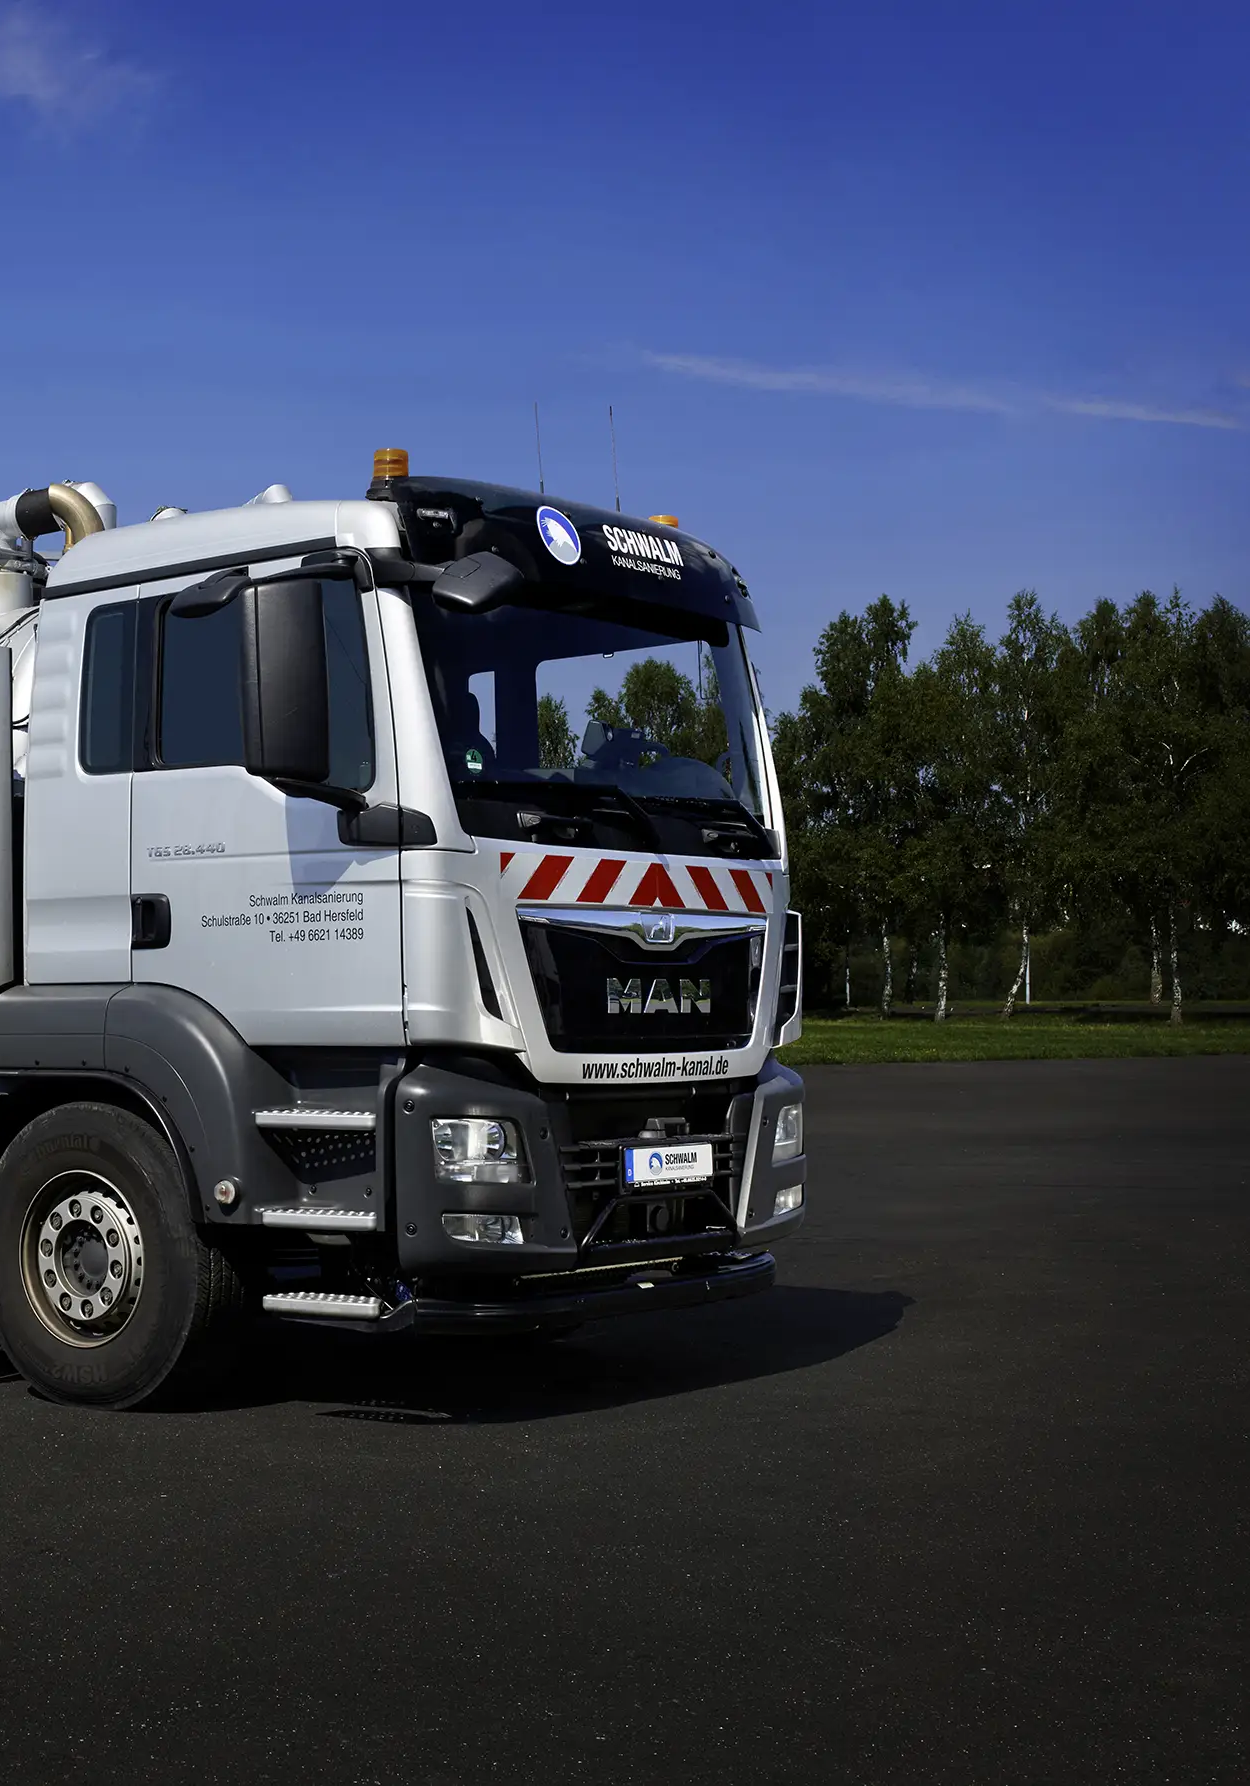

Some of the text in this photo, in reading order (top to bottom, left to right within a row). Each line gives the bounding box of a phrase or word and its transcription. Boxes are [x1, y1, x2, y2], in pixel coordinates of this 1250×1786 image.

[602, 524, 684, 567] SCHWALM
[611, 555, 681, 580] KANALSANIERUNG
[471, 750, 476, 761] 4
[147, 846, 171, 858] TGS
[250, 892, 363, 907] Schwalm Kanalsanierung
[201, 909, 363, 928] Schulstraße 10 36251 Bad Hersfeld
[269, 928, 364, 942] Tel. +49 6621 14389
[607, 978, 711, 1014] MAN
[582, 1056, 729, 1079] www.schwalm-kanal.de
[665, 1152, 697, 1165] SCHWALM
